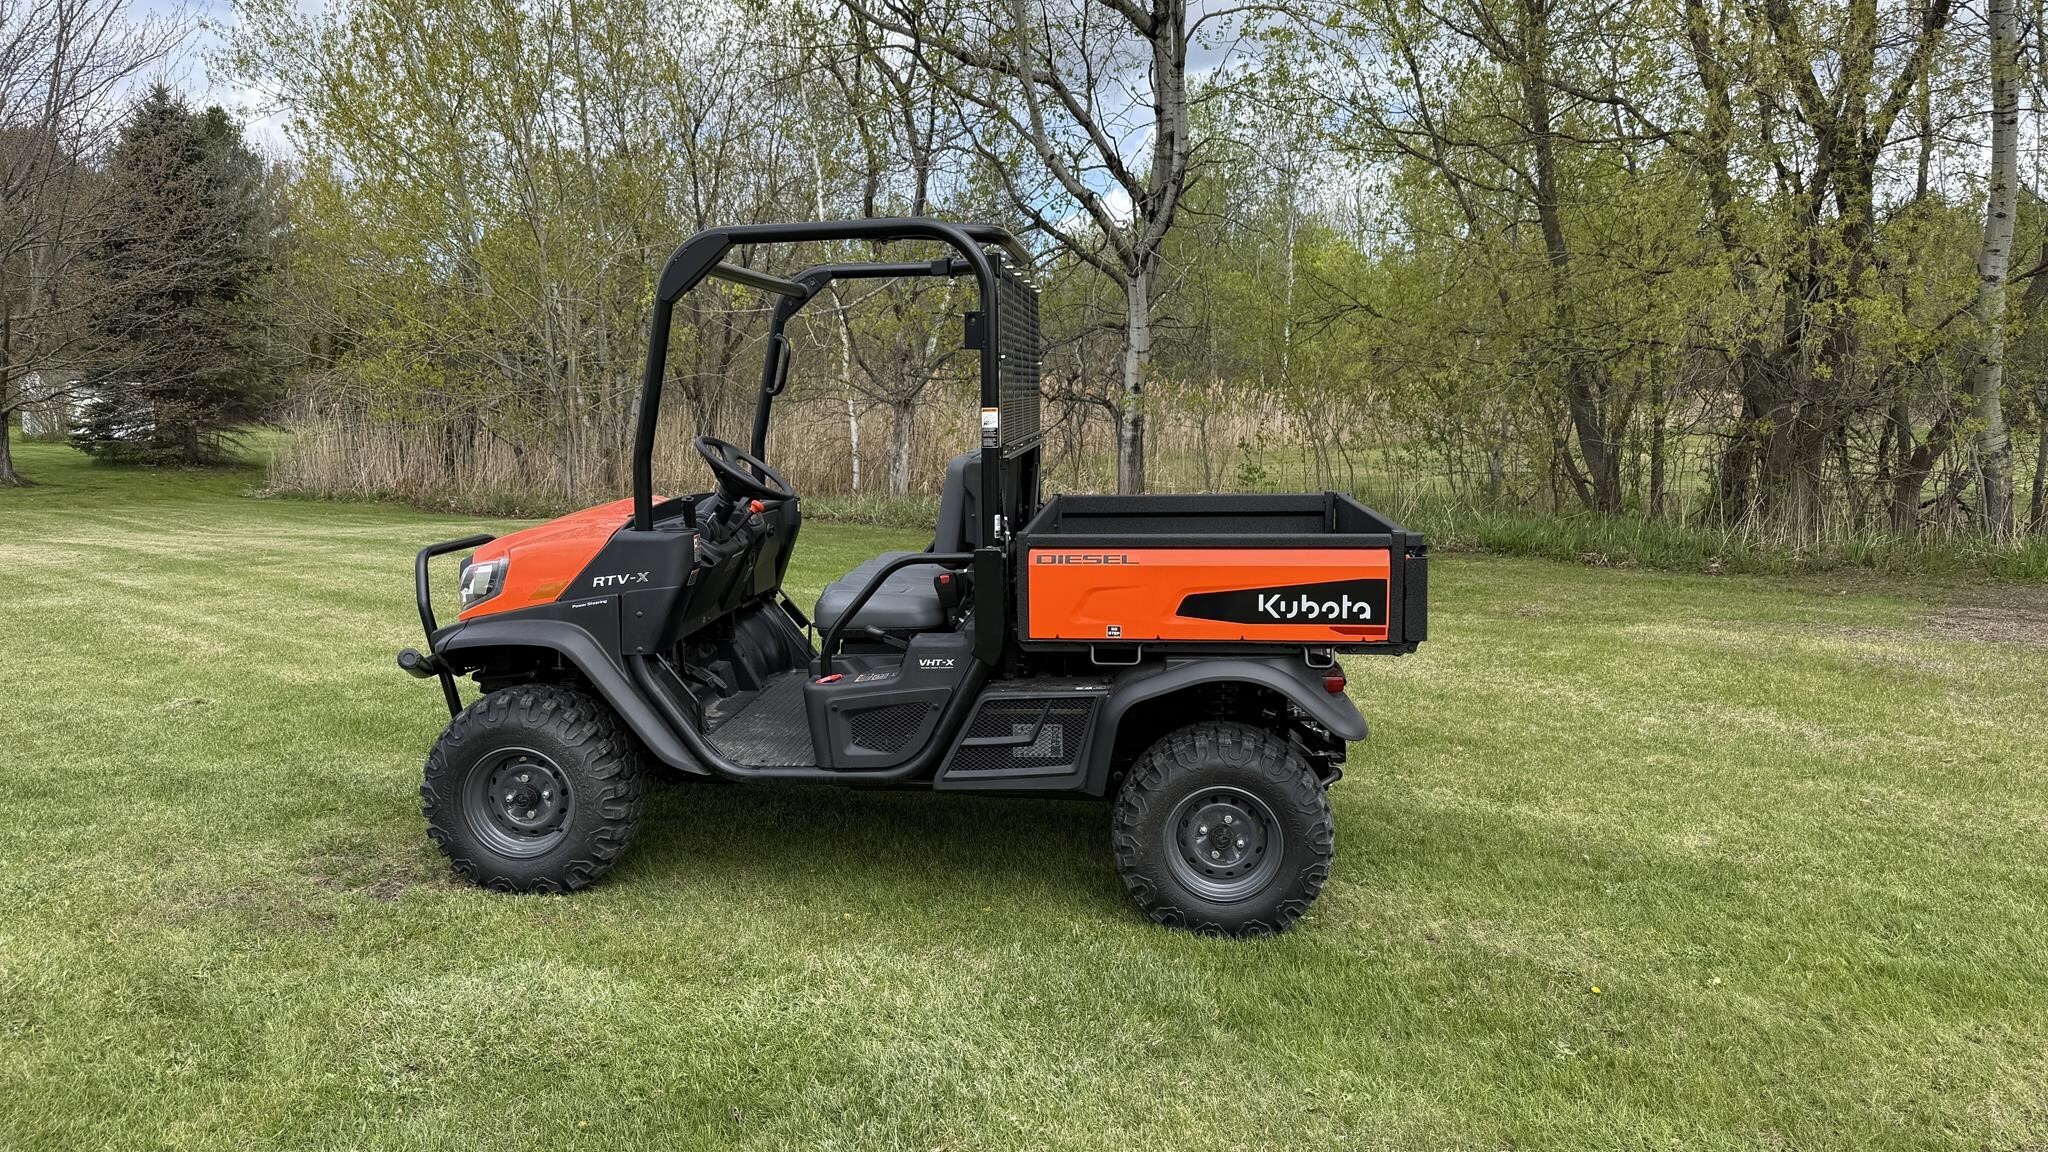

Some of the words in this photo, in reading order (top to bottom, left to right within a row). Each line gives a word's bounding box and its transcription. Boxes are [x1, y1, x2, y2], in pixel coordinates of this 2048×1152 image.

[1037, 555, 1139, 564] DIESEL
[593, 571, 650, 588] RTV-X
[1259, 594, 1371, 619] Kubota
